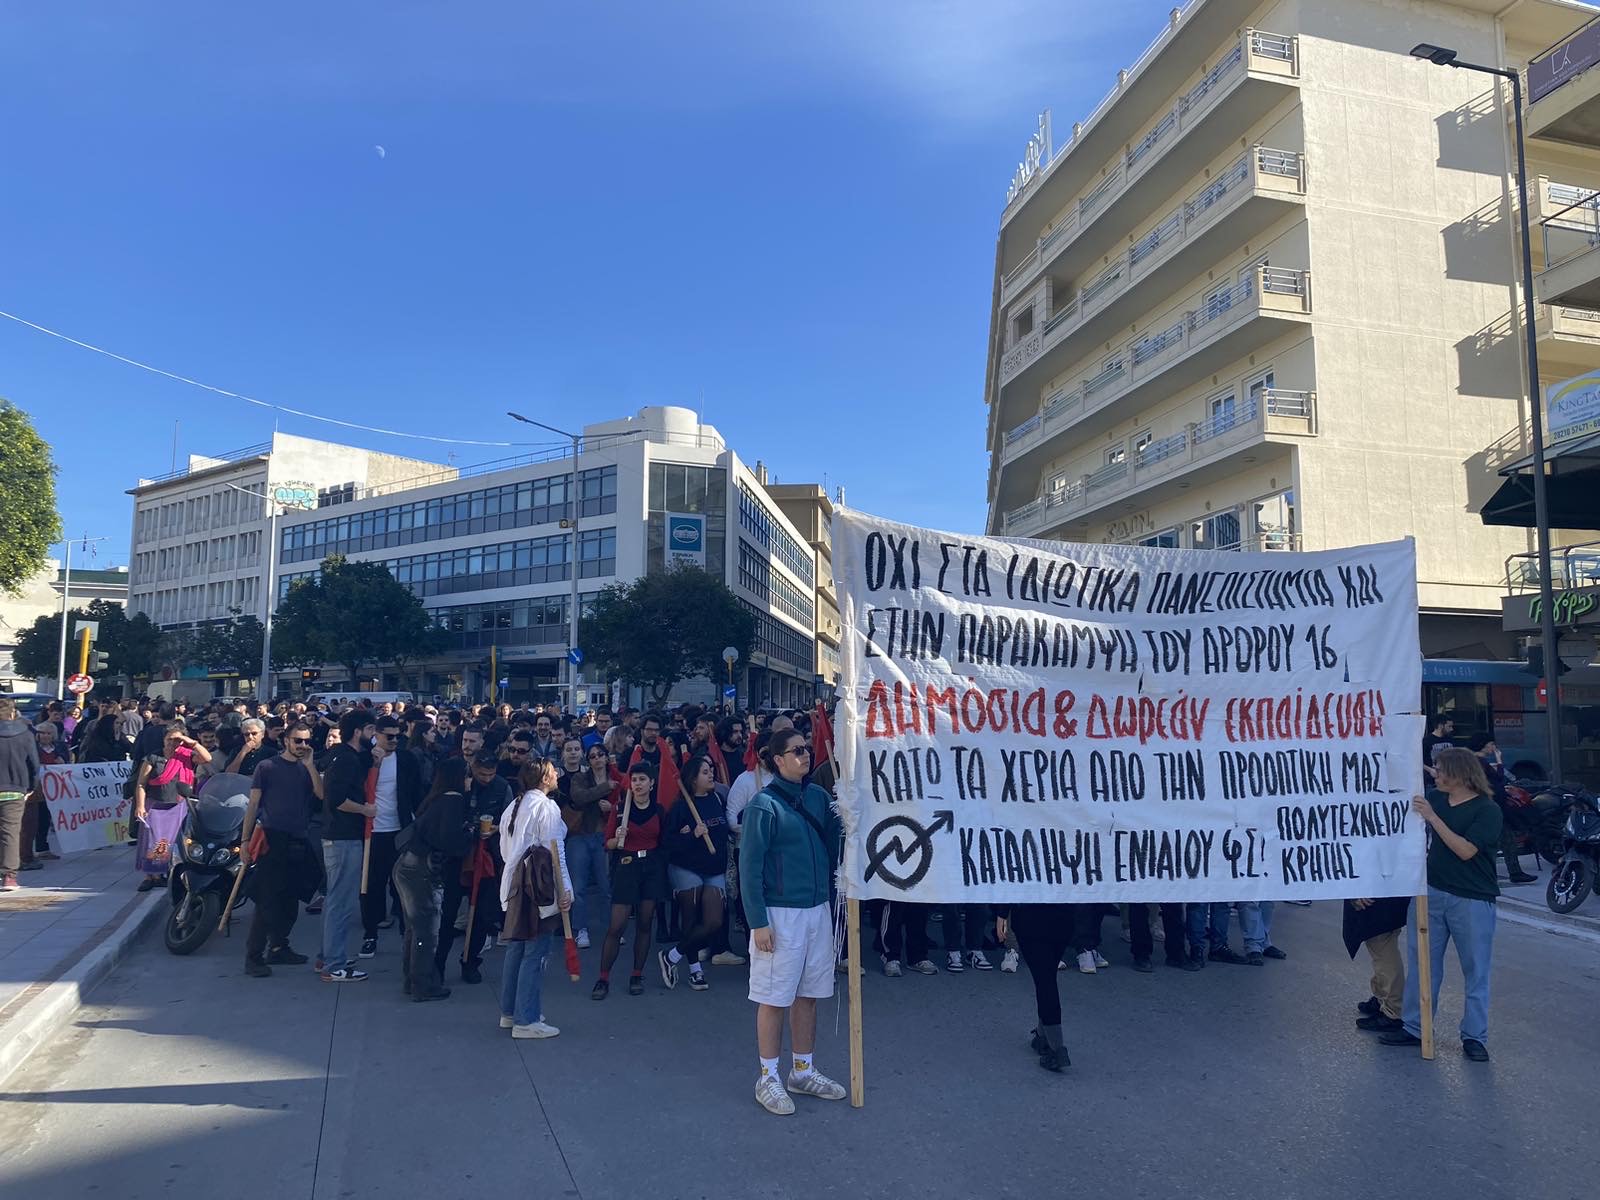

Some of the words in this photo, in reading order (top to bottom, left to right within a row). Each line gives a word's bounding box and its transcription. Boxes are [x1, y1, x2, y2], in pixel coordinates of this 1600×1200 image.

[865, 531, 920, 591] ΟΧΙ
[937, 543, 991, 597] ΣΤΑ
[1147, 568, 1334, 615] ΠΑΝΕΠΙΣΤΗΜΙΑ
[865, 607, 944, 660] ΣΤΗΝ
[958, 613, 1138, 673] ΠΑΡΑΚΑΜΨΗ
[1142, 629, 1191, 675] ΤΟΥ
[1202, 624, 1295, 674] ΑΡΘΡΟΥ
[1305, 624, 1338, 670] 16
[1053, 690, 1078, 739] &
[1086, 689, 1210, 745] Δωρεάν
[869, 747, 944, 803] ΚΑΤΩ
[950, 746, 987, 800] ΤΑ
[1000, 749, 1079, 803] ΧΕΡΙΑ
[1090, 750, 1145, 801] ΑΠΟ
[1153, 749, 1205, 801] ΤΗΝ
[1219, 749, 1334, 800] ΠΡΟΟΠΤΙΚΗ
[1276, 800, 1410, 841] ΠΟΛΥΤΕΧΝΕΙΟΥ
[959, 827, 1103, 886] ΚΑΤΑΛΗΨΗ
[1114, 829, 1214, 882] ΕΝΙΑΙΟΥ
[1280, 842, 1360, 885] ΚΡΗΤΗΣ
